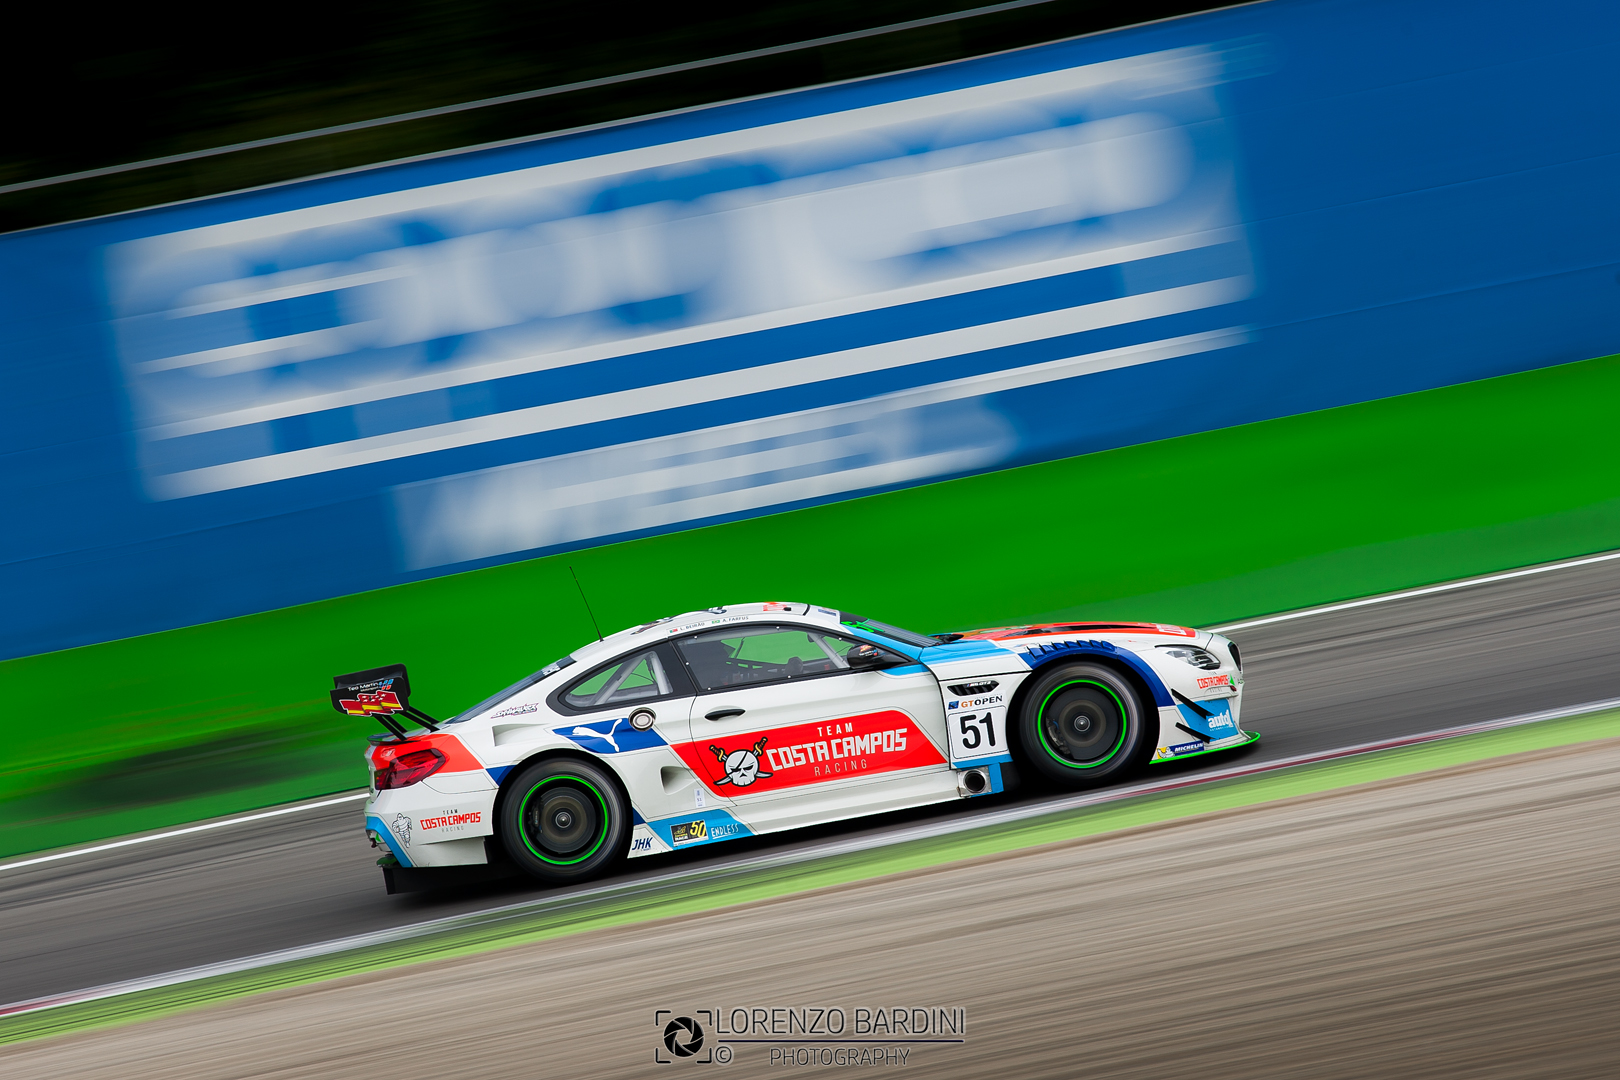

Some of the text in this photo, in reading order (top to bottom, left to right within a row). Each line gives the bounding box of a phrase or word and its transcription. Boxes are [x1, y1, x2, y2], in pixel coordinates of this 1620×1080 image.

[817, 722, 853, 737] TEAM
[960, 712, 996, 749] 51
[766, 728, 907, 771] COSTA CAMPOS
[1174, 743, 1204, 752] MICHELIN
[814, 759, 868, 776] RACING
[420, 812, 481, 830] COSTA CAMPOS
[690, 820, 706, 838] 50
[711, 823, 739, 838] ENDLESS
[632, 837, 653, 850] JHK
